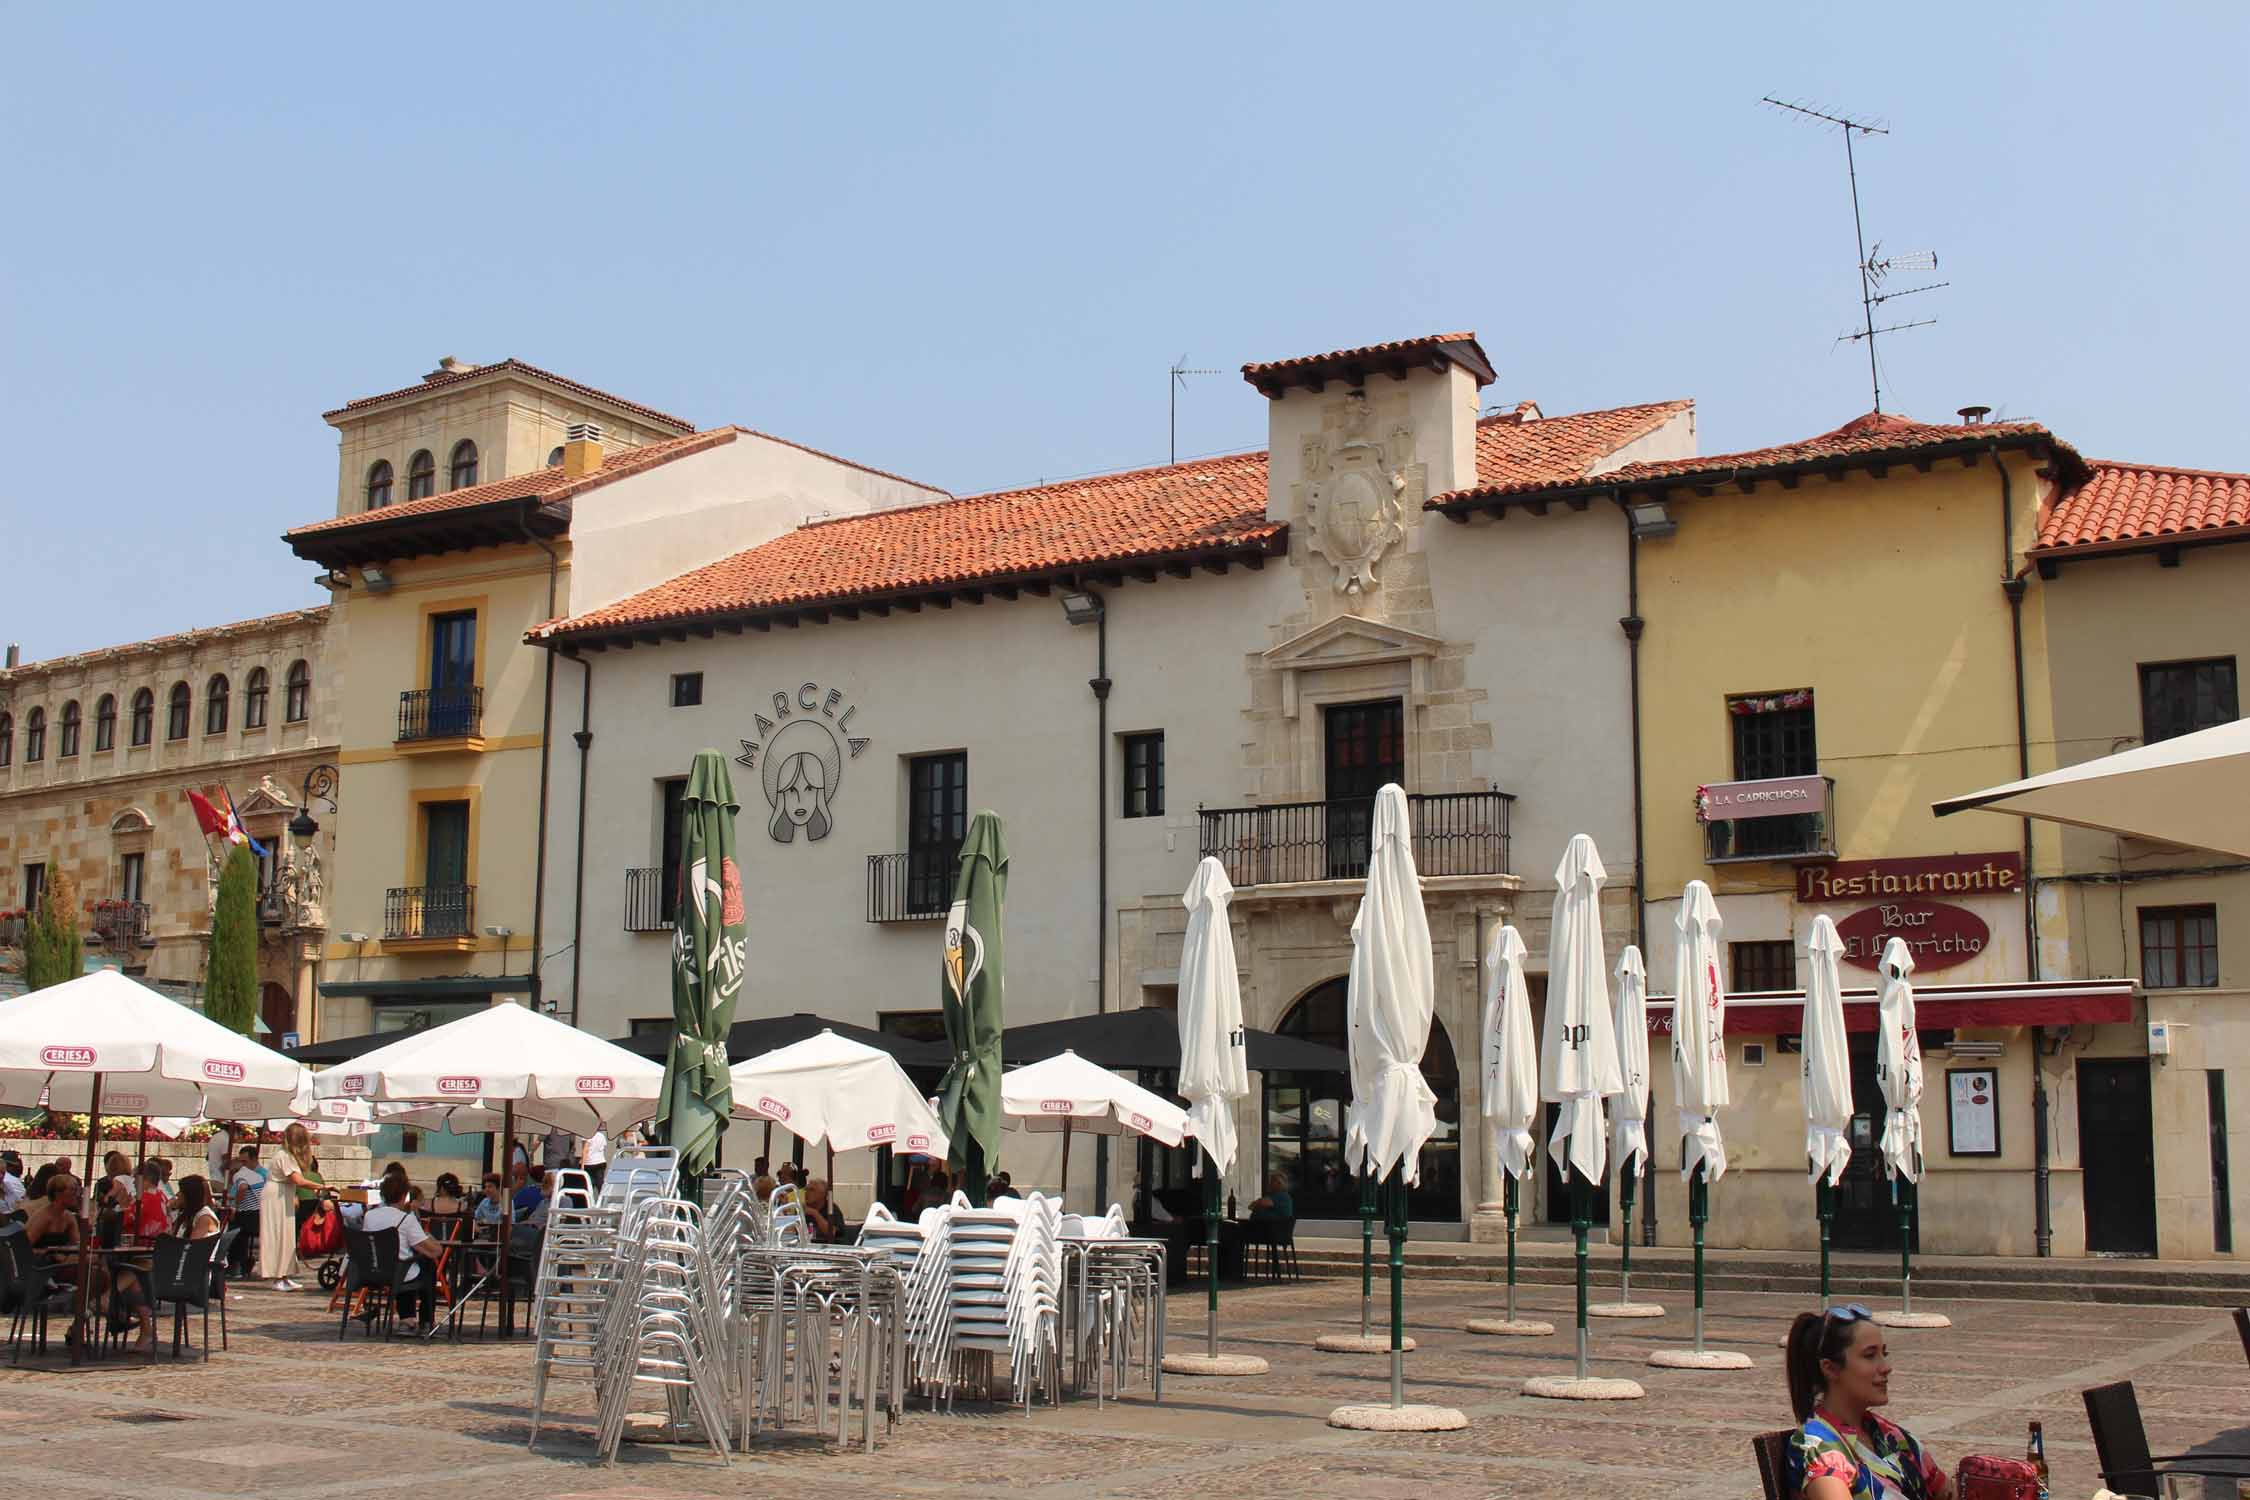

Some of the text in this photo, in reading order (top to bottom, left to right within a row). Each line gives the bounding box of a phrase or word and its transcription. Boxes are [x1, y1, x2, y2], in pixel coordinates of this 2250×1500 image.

[735, 683, 870, 767] MARCELA
[1715, 789, 1808, 806] LA CAPRICHOSA
[1801, 862, 2015, 898] Restaurante
[1879, 903, 1935, 928] Bar
[1846, 936, 1865, 958] El
